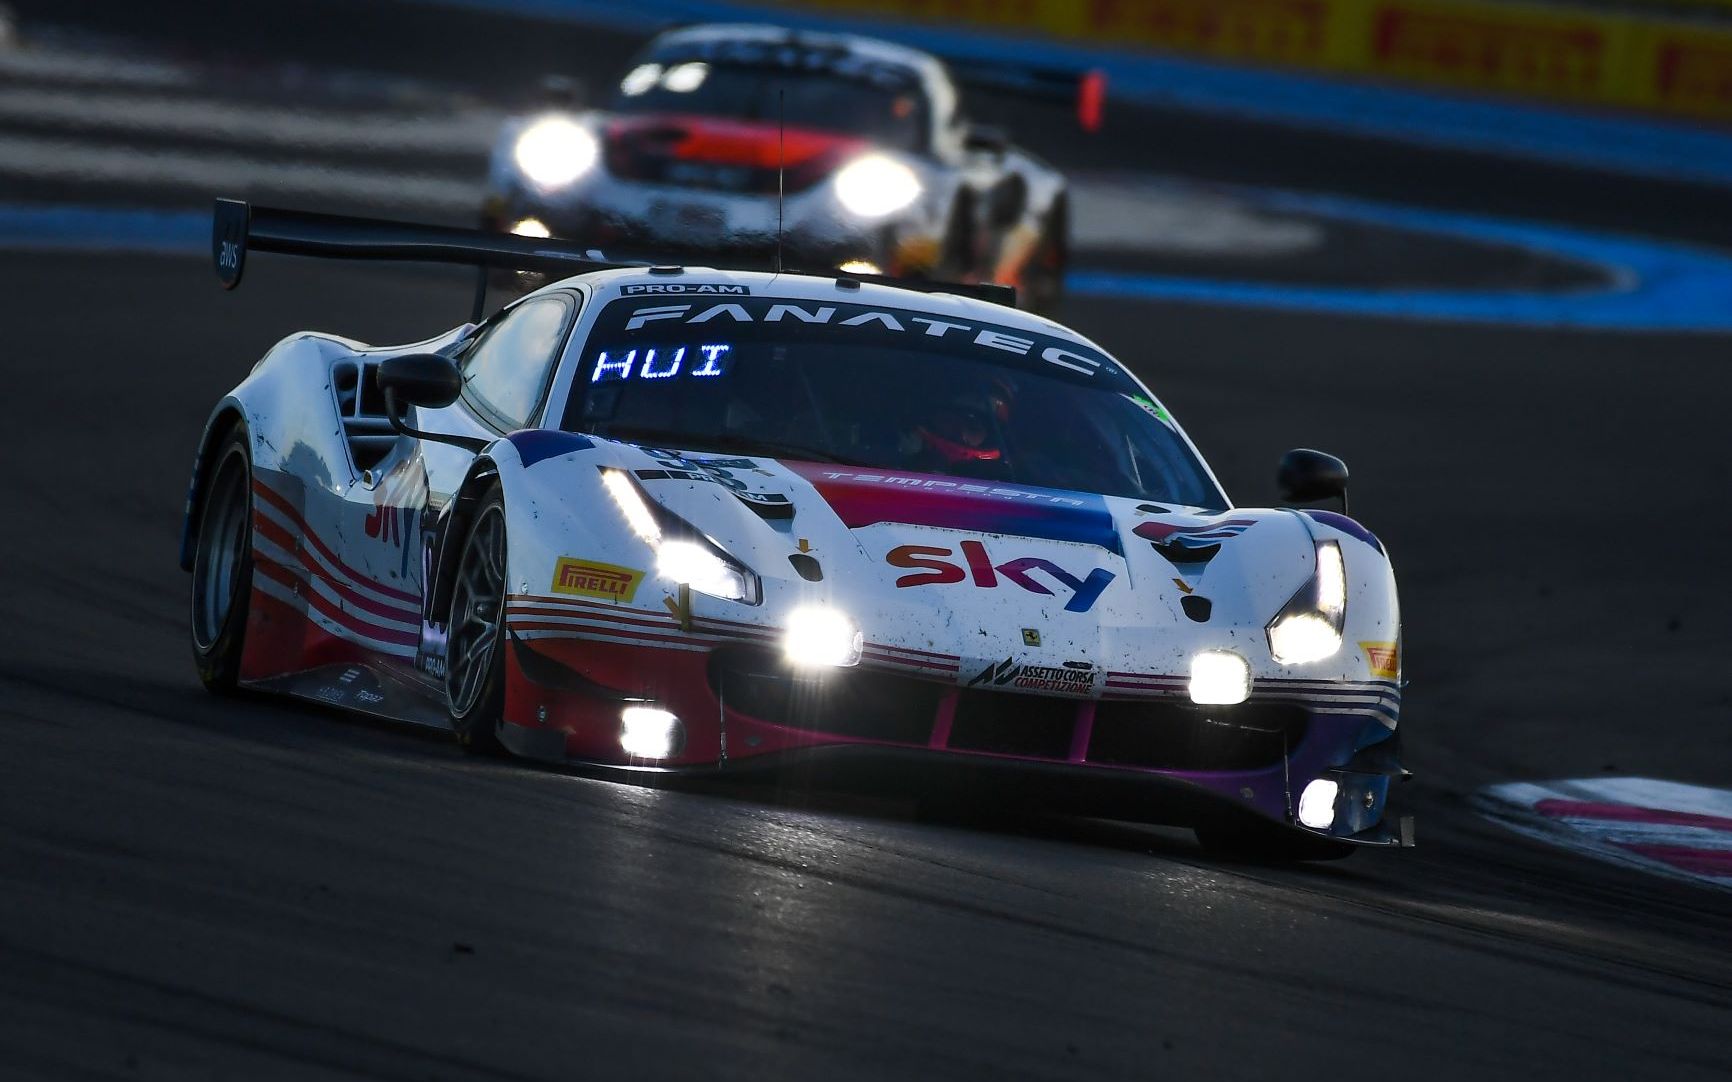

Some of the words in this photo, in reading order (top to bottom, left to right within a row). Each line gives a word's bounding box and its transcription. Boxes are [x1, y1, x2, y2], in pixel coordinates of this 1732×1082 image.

[219, 241, 238, 269] aws
[627, 284, 745, 295] PRO-AM
[624, 303, 1101, 377] FANATEC
[592, 345, 730, 382] HUI
[822, 472, 1085, 507] TEMPESTA
[559, 564, 633, 595] PIRELLI
[886, 540, 1116, 613] sky
[1014, 677, 1093, 695] COMPETIZIONE
[1020, 665, 1064, 681] ASSETTO
[1064, 668, 1095, 684] CORSA
